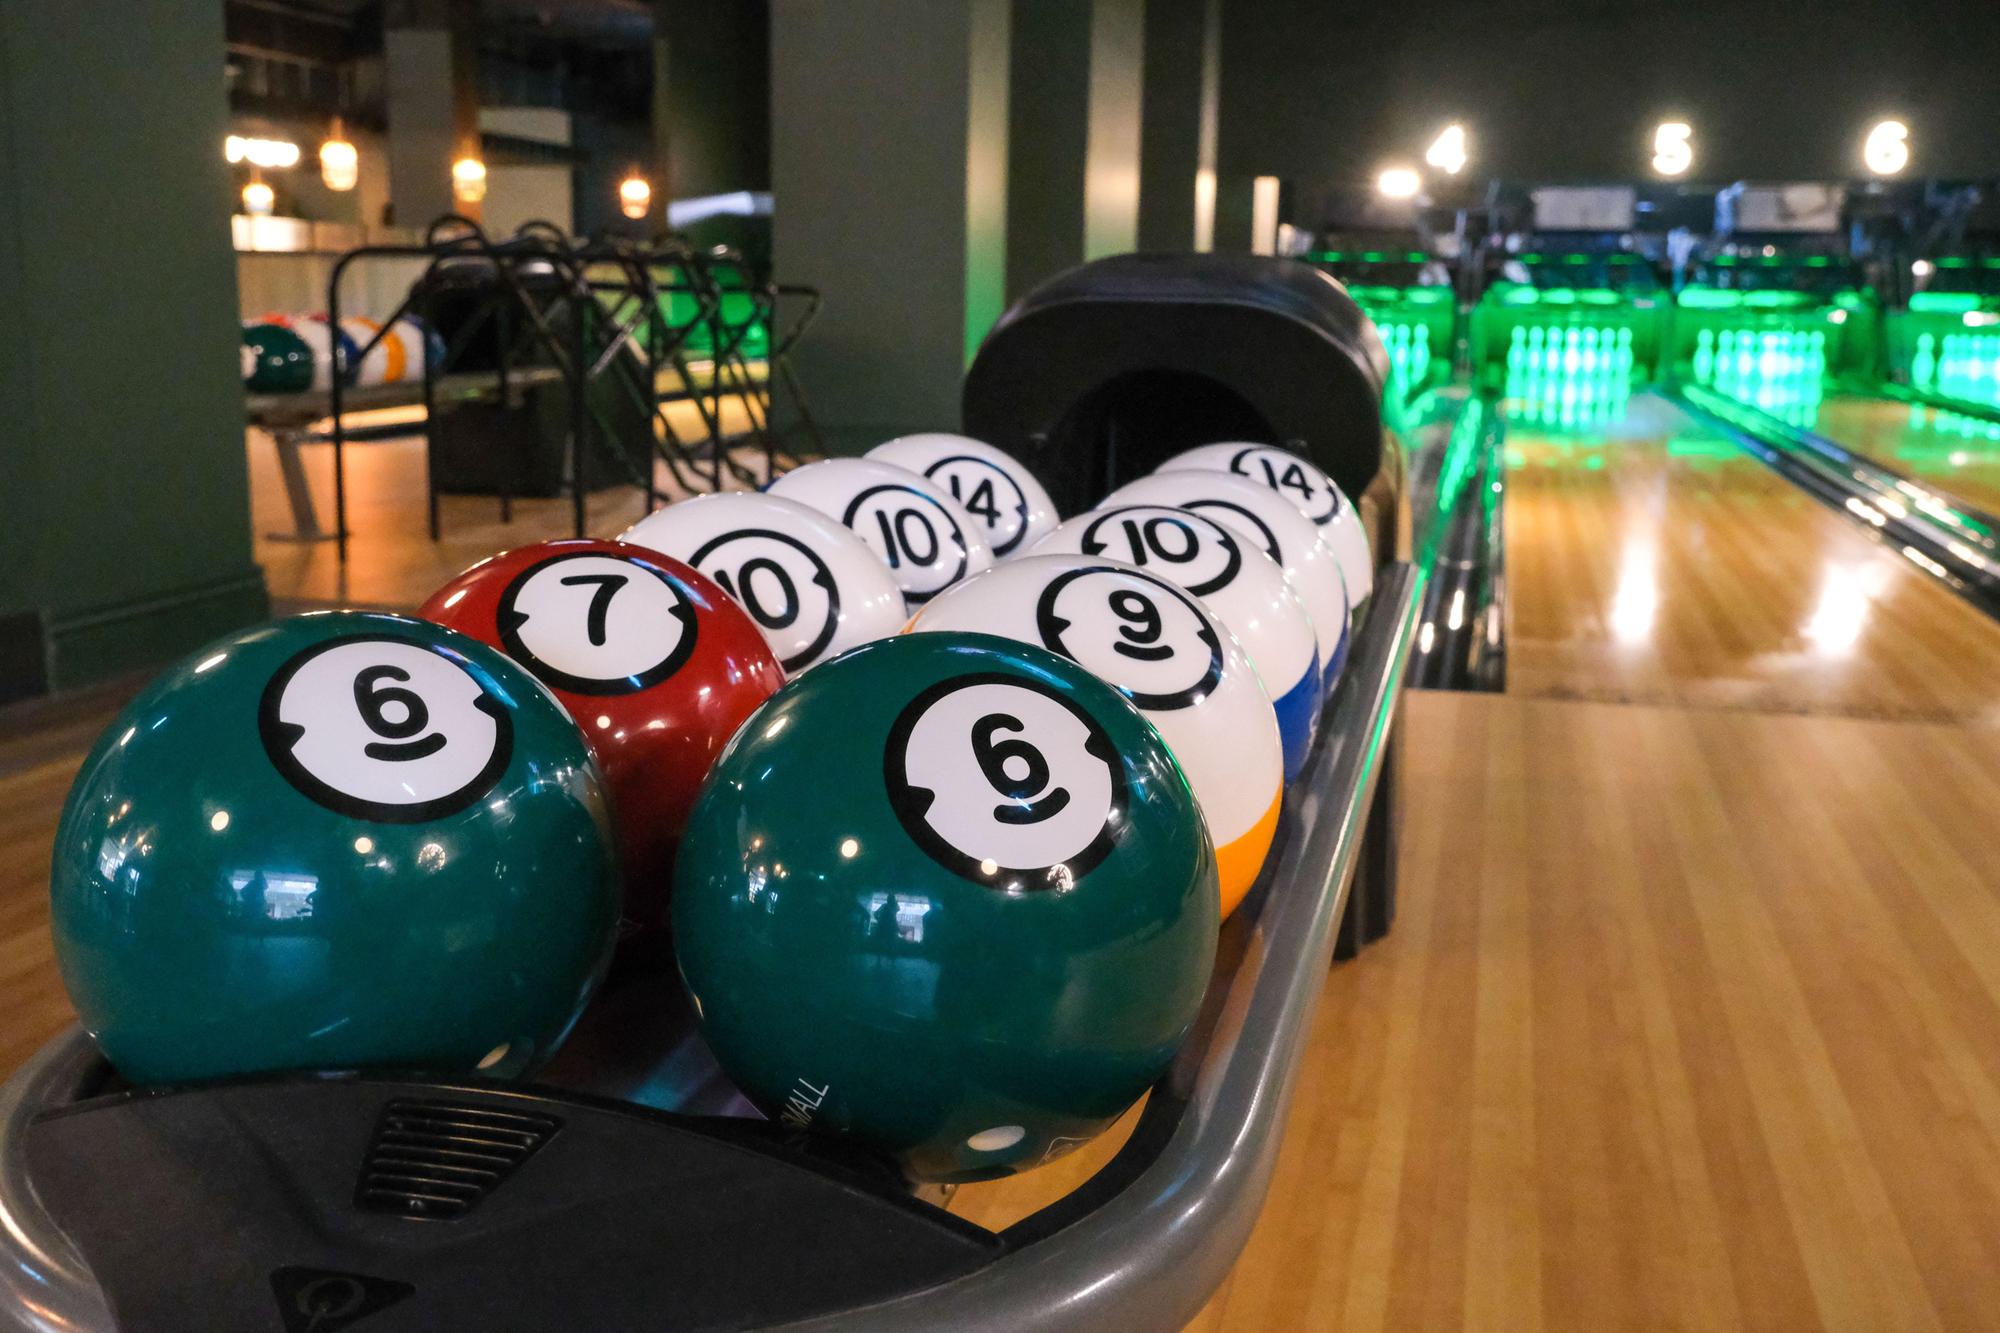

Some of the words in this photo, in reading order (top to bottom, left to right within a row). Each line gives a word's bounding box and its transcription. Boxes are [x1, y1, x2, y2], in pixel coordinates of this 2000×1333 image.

[1424, 123, 1470, 176] 4
[1651, 121, 1693, 177] 5
[1862, 119, 1909, 176] 6
[1258, 456, 1315, 501] 14
[874, 507, 940, 571] 10
[1120, 516, 1201, 568] 10
[559, 573, 630, 648] 7
[1107, 588, 1163, 647] 9
[352, 663, 431, 742] 6
[969, 711, 1052, 802] 6
